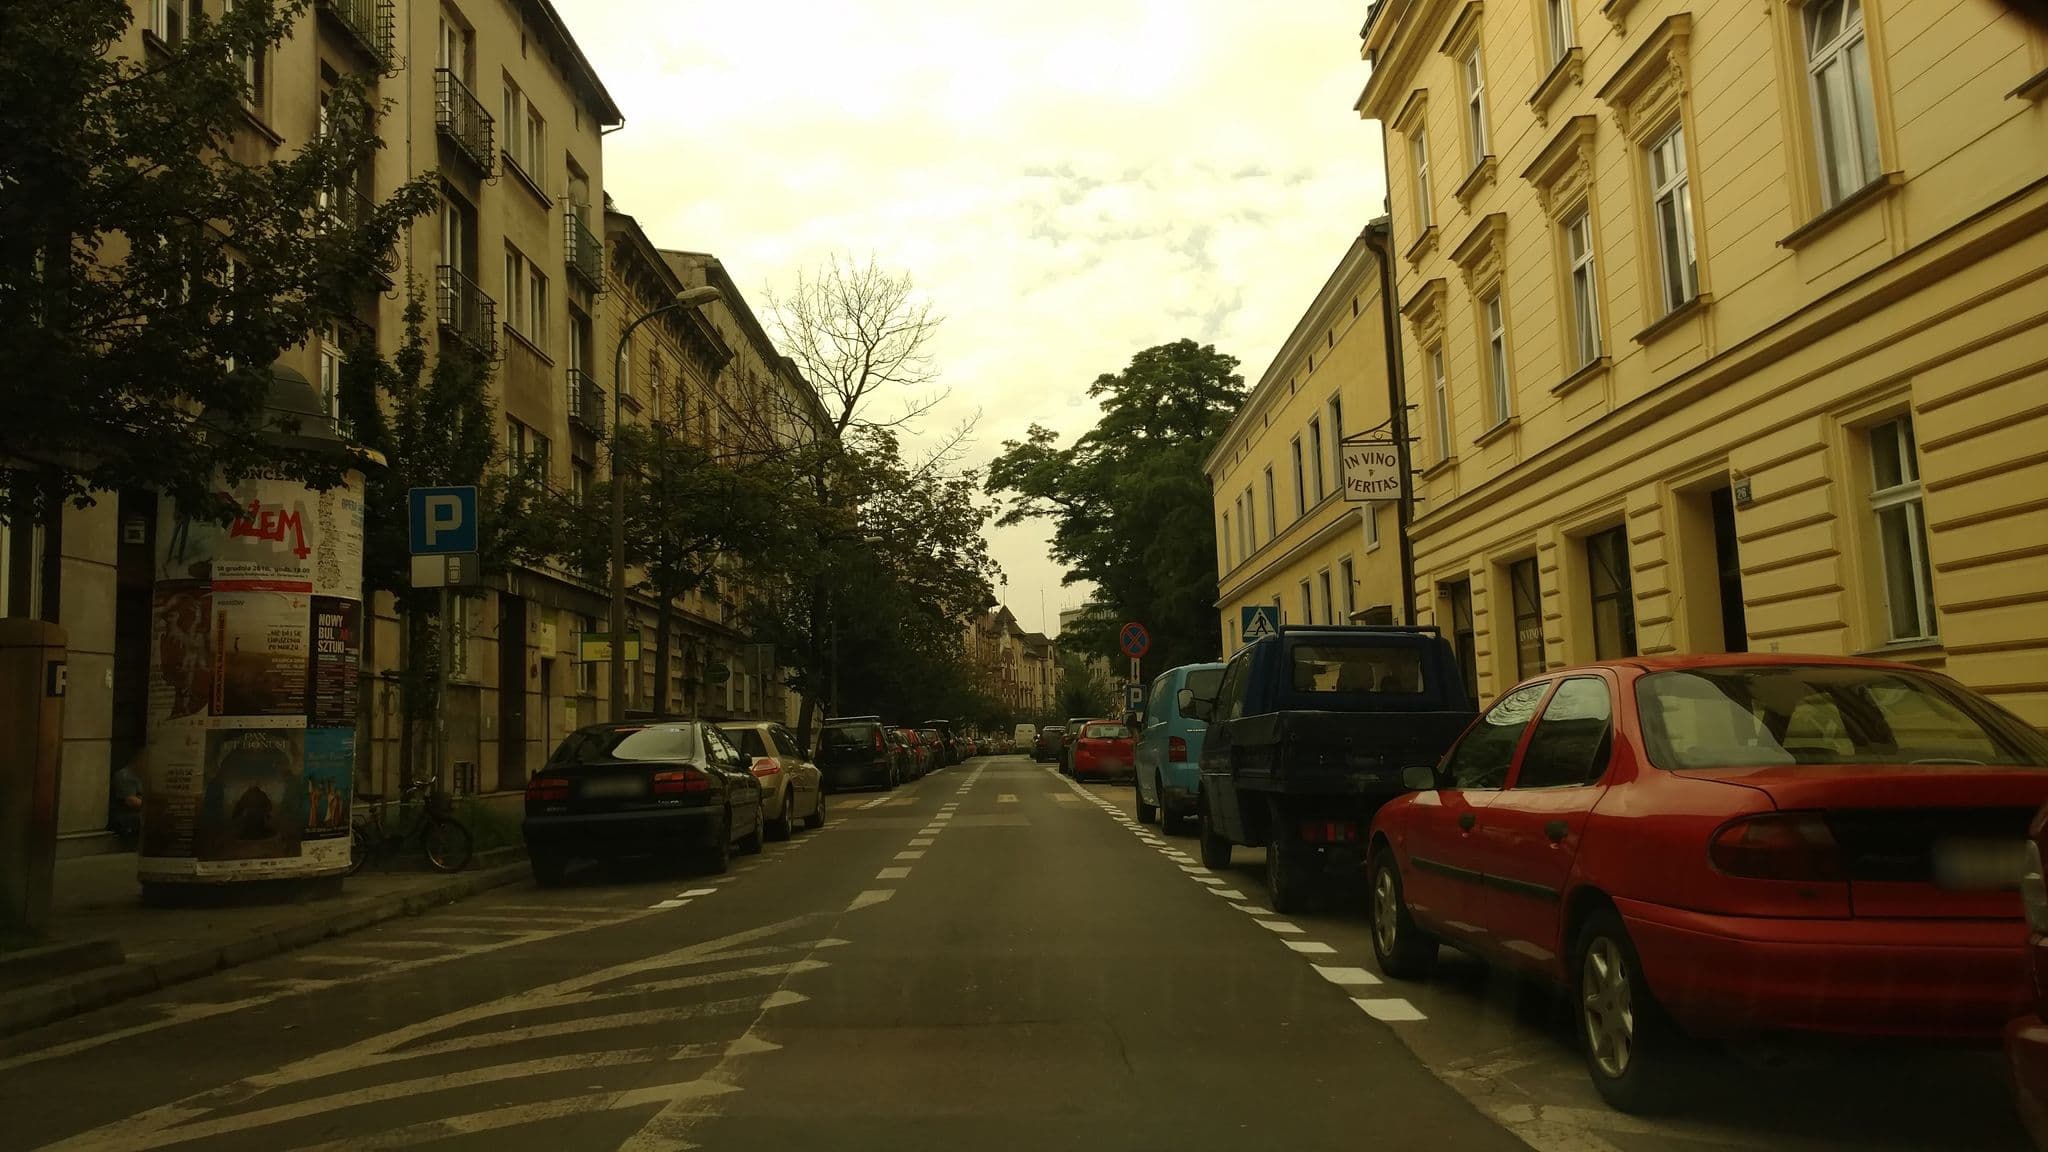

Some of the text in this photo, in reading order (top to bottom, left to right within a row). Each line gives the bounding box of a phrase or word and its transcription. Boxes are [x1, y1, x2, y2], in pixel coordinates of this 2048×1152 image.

[1344, 452, 1396, 469] IN VINO
[1347, 476, 1398, 493] VERITAS
[1736, 487, 1747, 498] 26
[425, 494, 462, 546] P
[318, 613, 343, 628] NOWY
[318, 640, 344, 653] SZTUKI
[1130, 687, 1142, 709] P
